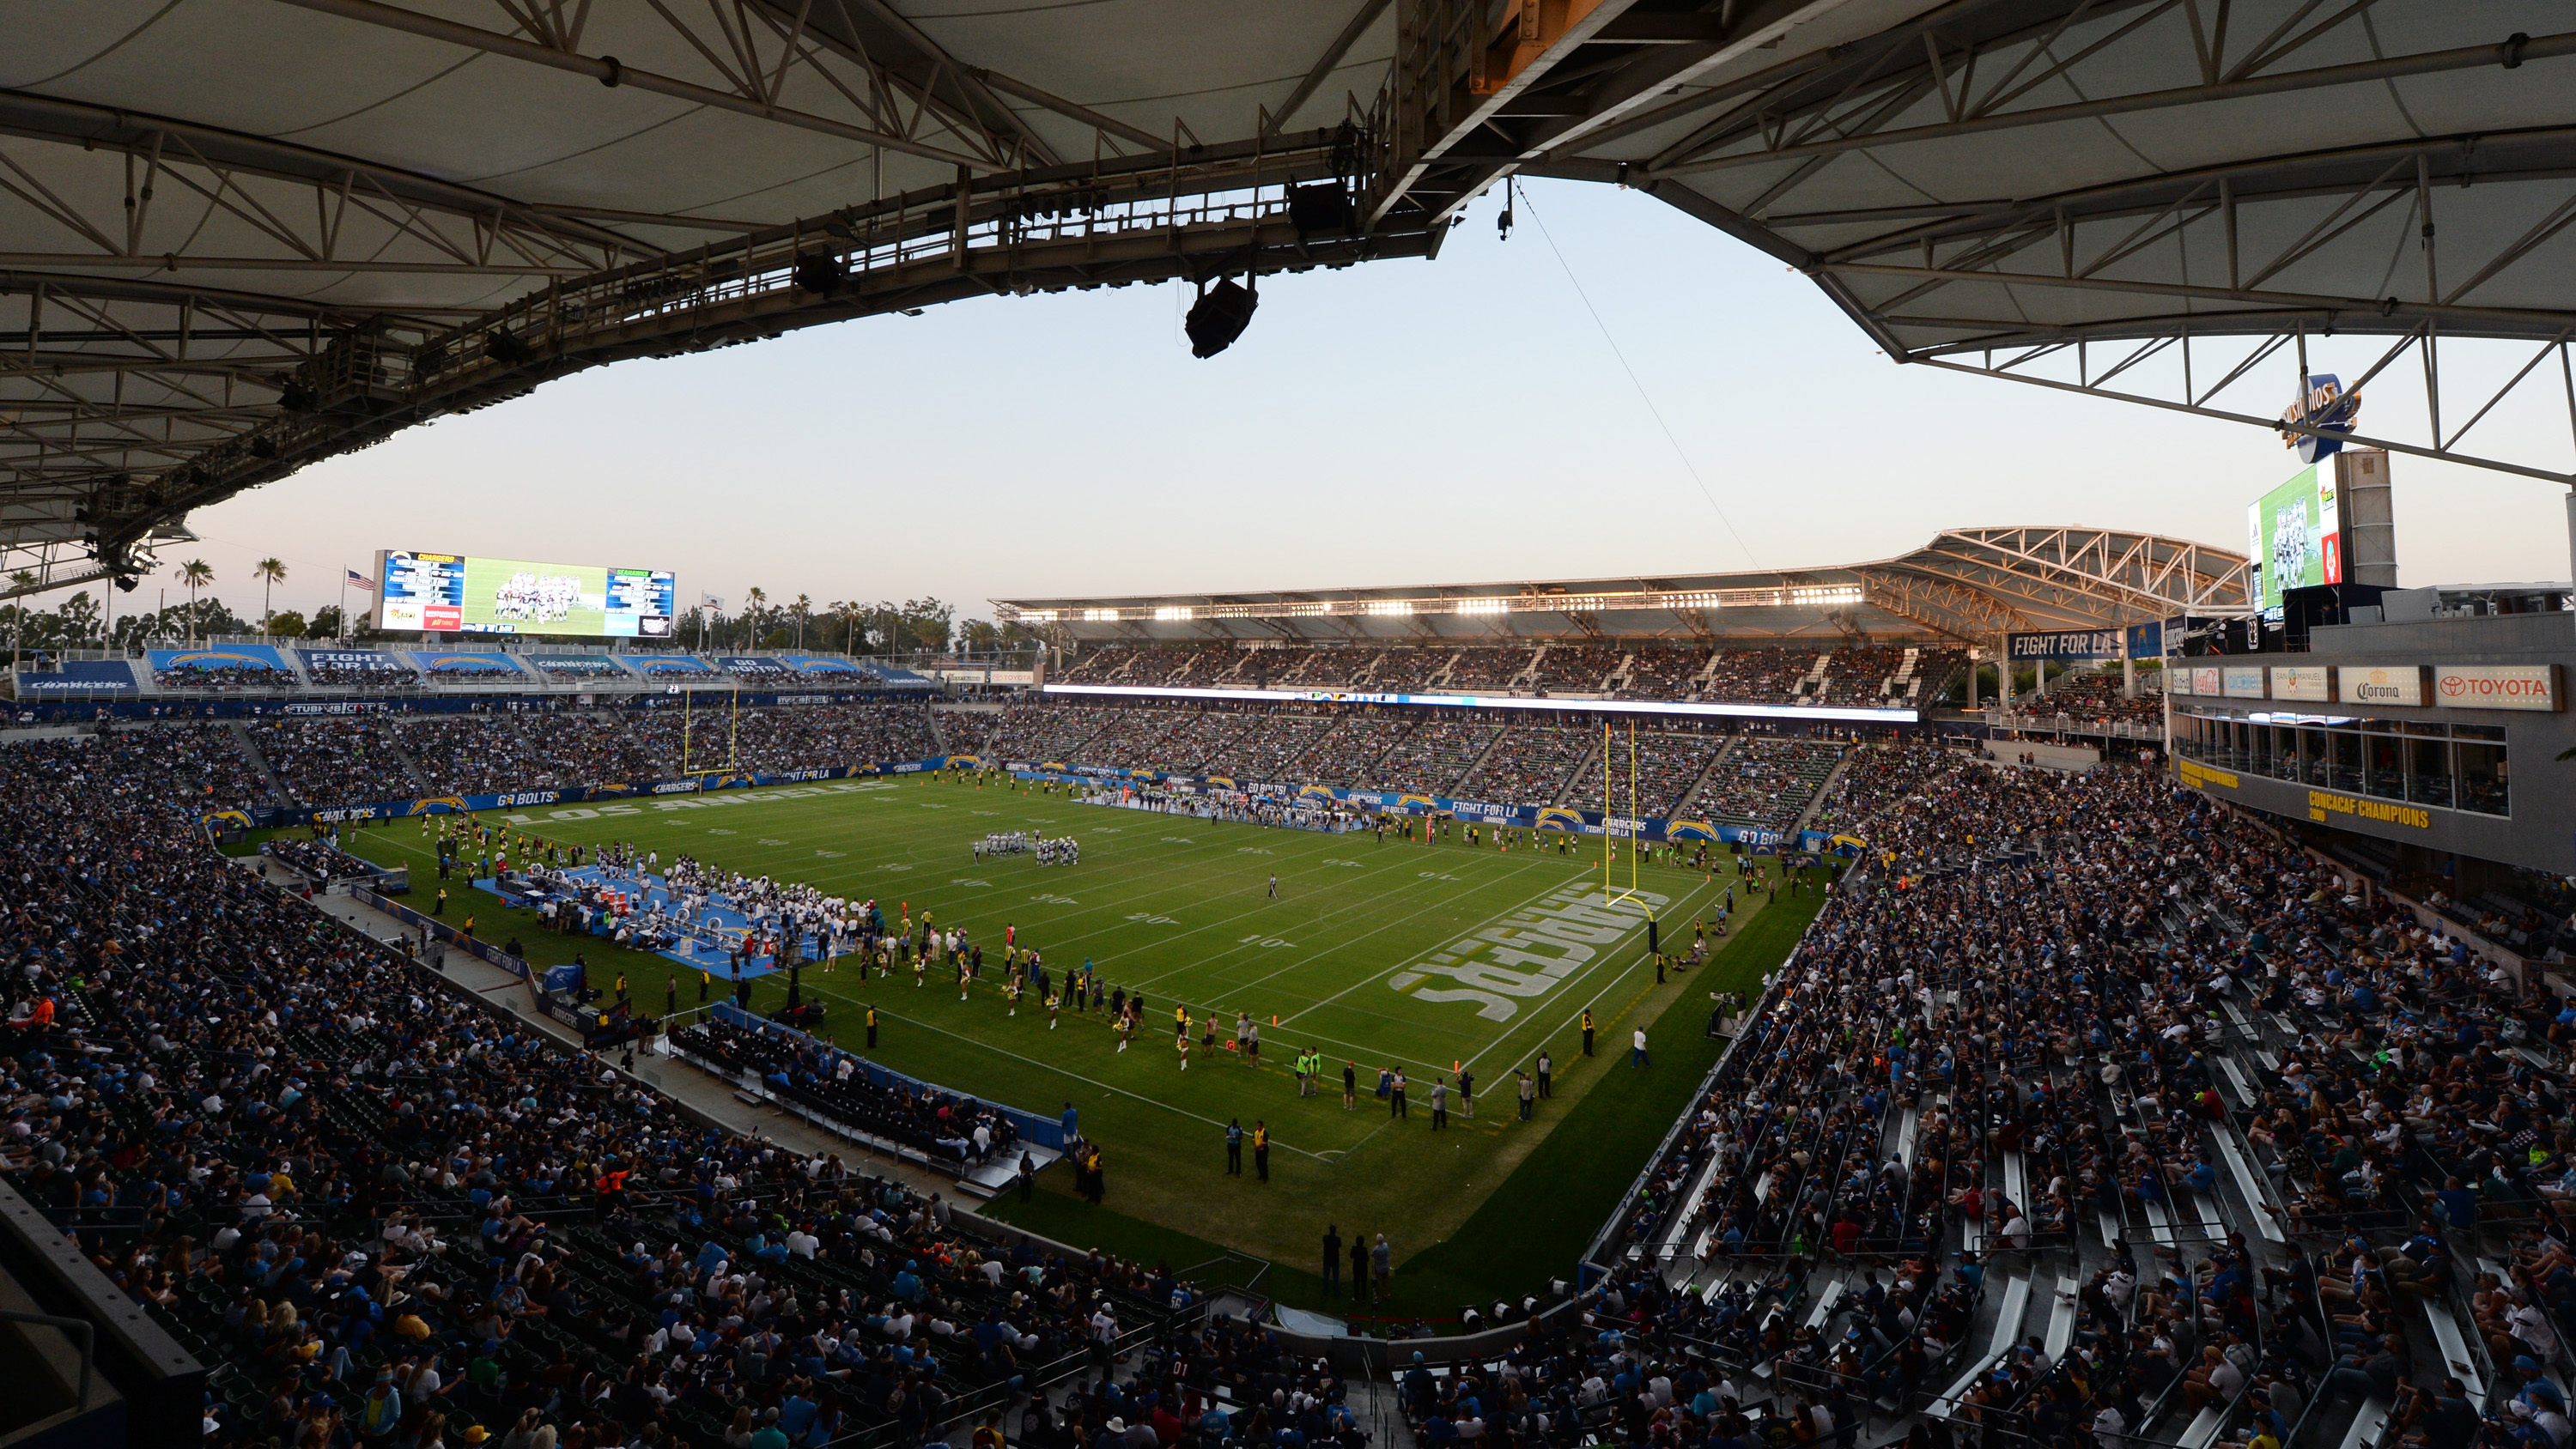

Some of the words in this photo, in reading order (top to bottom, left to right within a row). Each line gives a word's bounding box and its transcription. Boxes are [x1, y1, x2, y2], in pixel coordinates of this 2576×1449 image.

[417, 554, 455, 563] CHARGERS
[2015, 635, 2057, 655] FIGHT
[2060, 634, 2088, 654] FOR
[2093, 634, 2111, 653] LA
[311, 653, 387, 662] FIGHT
[368, 662, 398, 670] LA
[2276, 672, 2287, 681] SAN
[2297, 672, 2322, 681] MANUEL
[2357, 682, 2400, 701] Corona
[2468, 679, 2547, 696] TOYOTA
[819, 769, 829, 779] LA
[656, 782, 696, 793] CHARGERS
[1248, 783, 1259, 793] GO
[1260, 784, 1287, 796] BOLTS!
[500, 804, 642, 826] LOS
[649, 781, 899, 810] ANGELES
[1348, 794, 1382, 804] CHARGERS
[1452, 802, 1483, 814] FIGHT
[1484, 804, 1504, 816] FOR
[1505, 807, 1518, 817] LA
[2309, 791, 2356, 815] CONCACAF
[2358, 800, 2430, 828] CHAMPIONS
[2309, 807, 2326, 822] 2000
[1585, 825, 1606, 834] FIGHT
[1620, 828, 1629, 837] LA
[1030, 894, 1072, 904] 30
[1124, 912, 1170, 925] 20
[1237, 935, 1285, 947] 10
[1388, 882, 1670, 1022] CHARGERS
[486, 948, 501, 967] FIGHT
[501, 954, 513, 971] FOR
[513, 960, 520, 974] LA
[551, 1006, 578, 1028] CHARGERS
[1227, 1041, 1234, 1050] G
[1170, 1296, 1182, 1310] 56
[1173, 1361, 1188, 1378] 01
